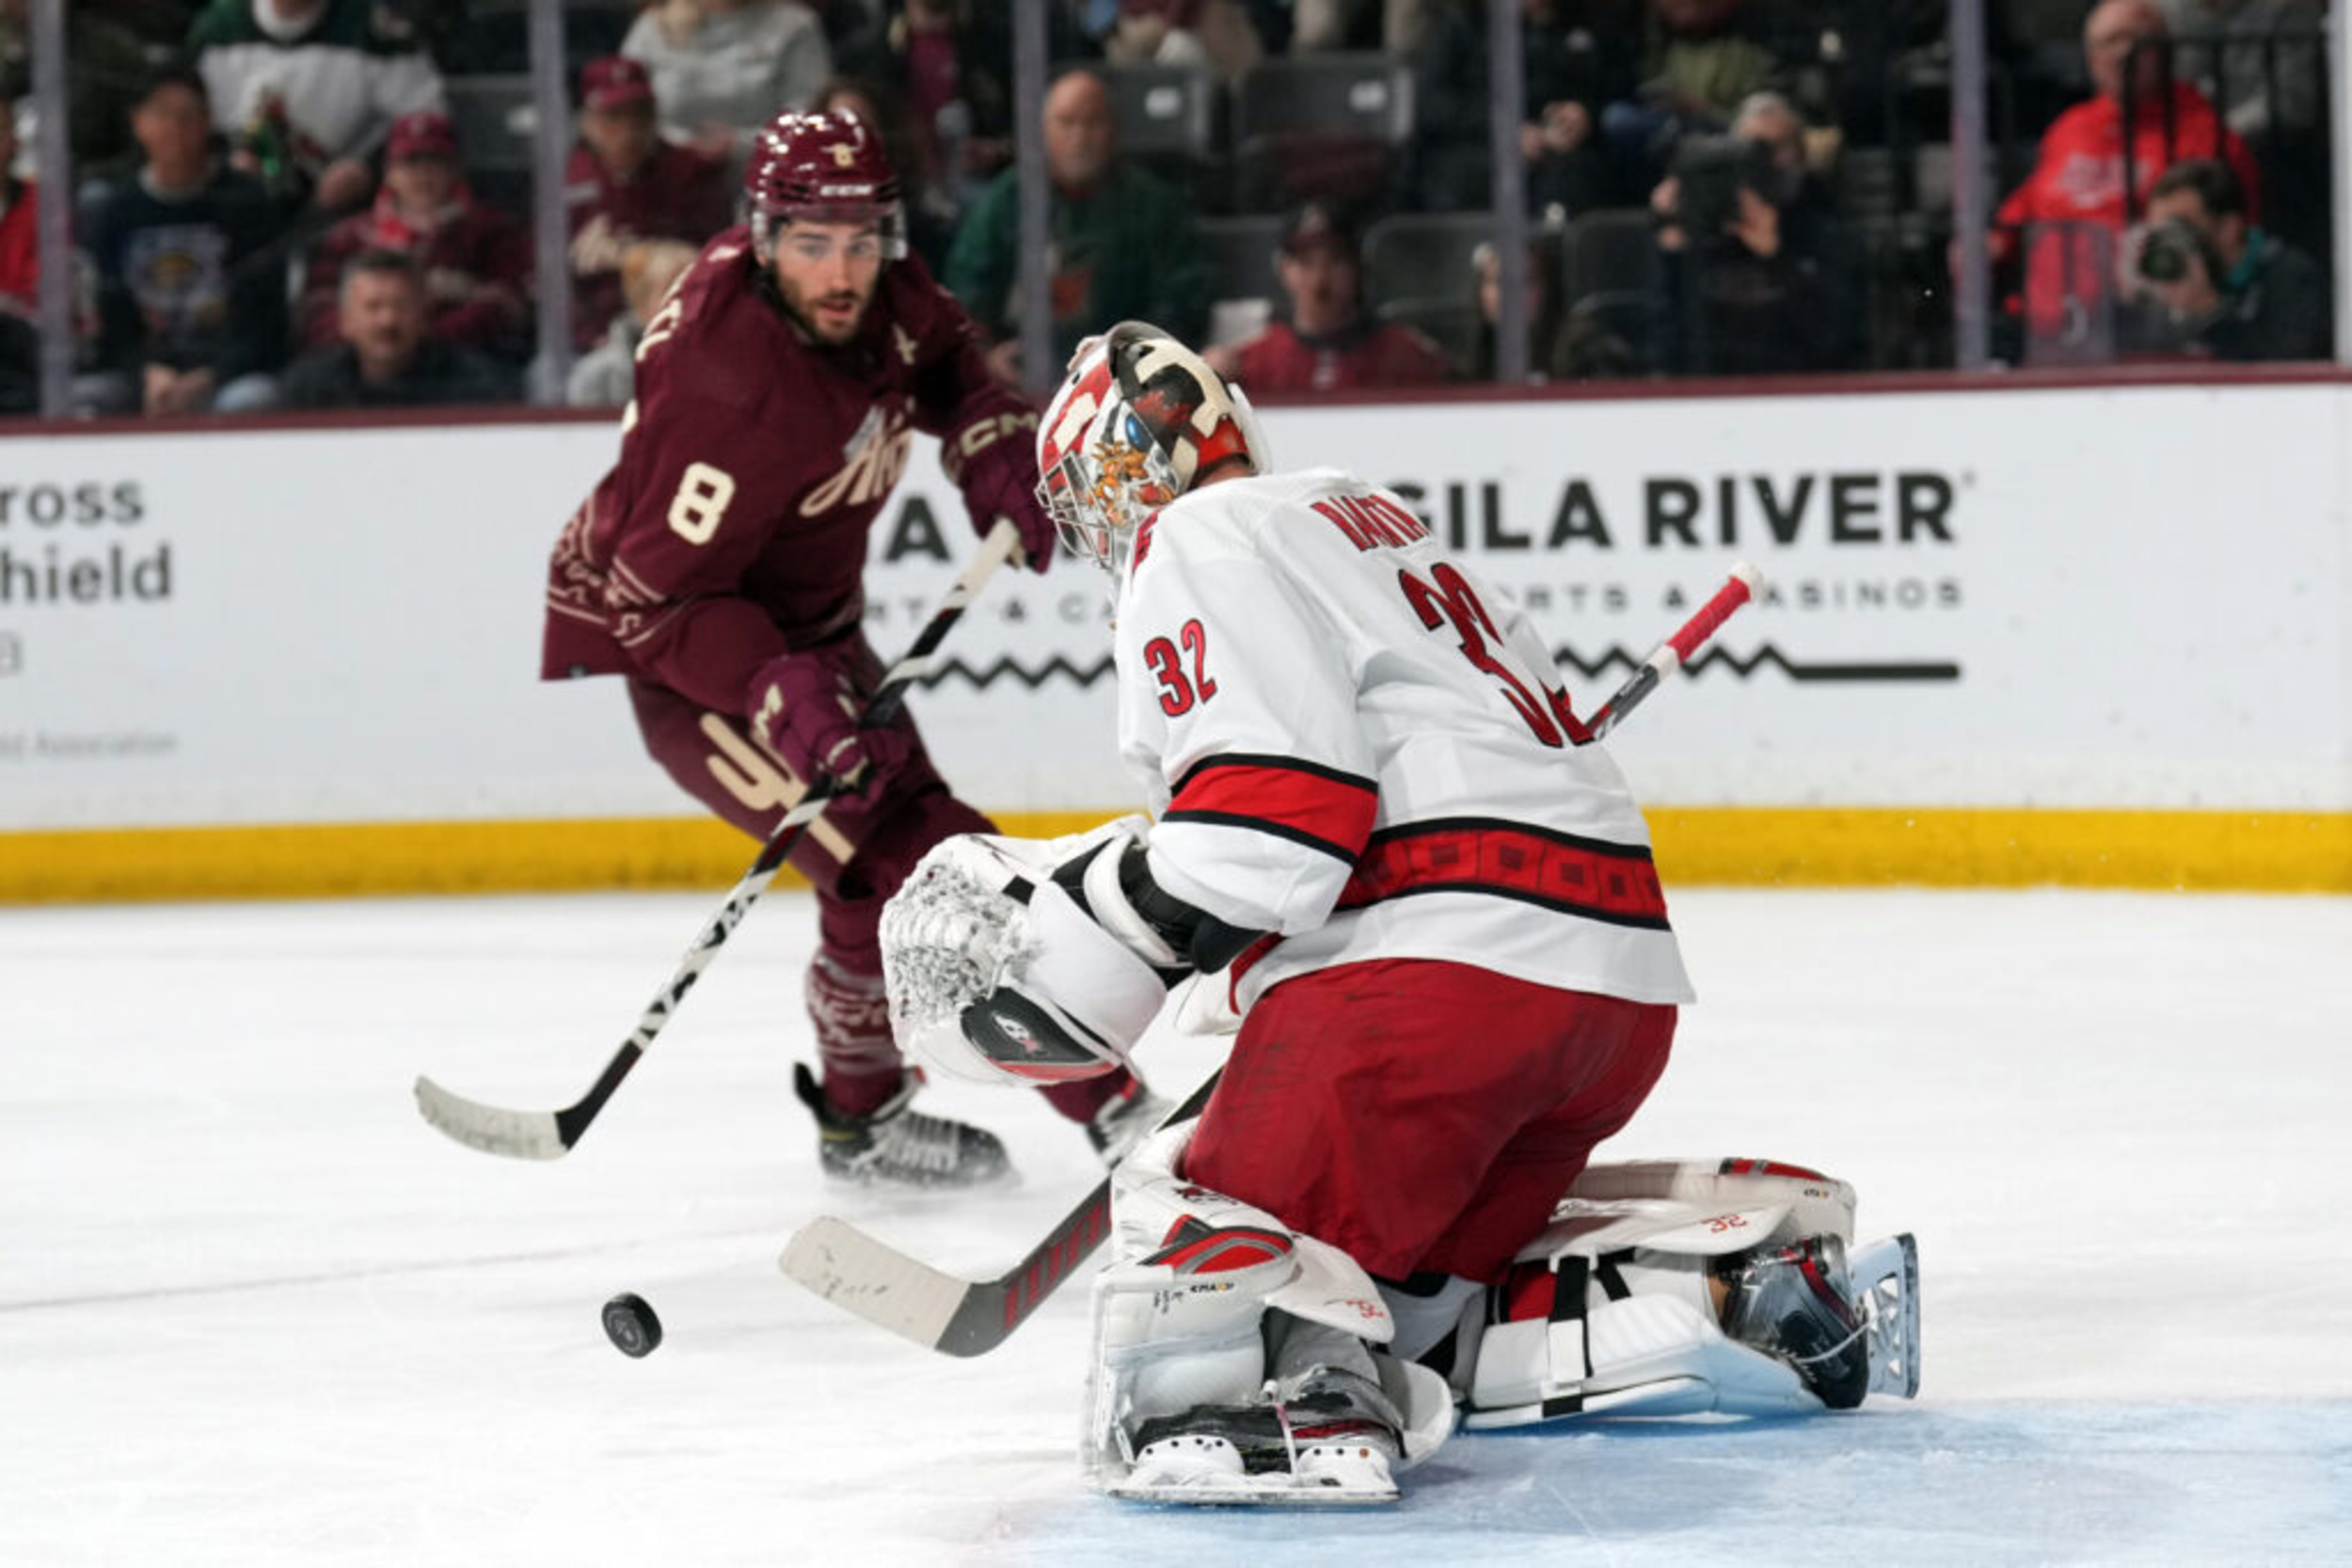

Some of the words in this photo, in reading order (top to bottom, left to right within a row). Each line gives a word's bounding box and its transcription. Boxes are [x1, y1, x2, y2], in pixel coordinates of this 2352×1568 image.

[667, 462, 736, 546] 8
[1644, 472, 1958, 547] RIVER
[0, 542, 172, 603] hield
[1757, 578, 1963, 613] ASINOS
[1143, 617, 1218, 718] 32
